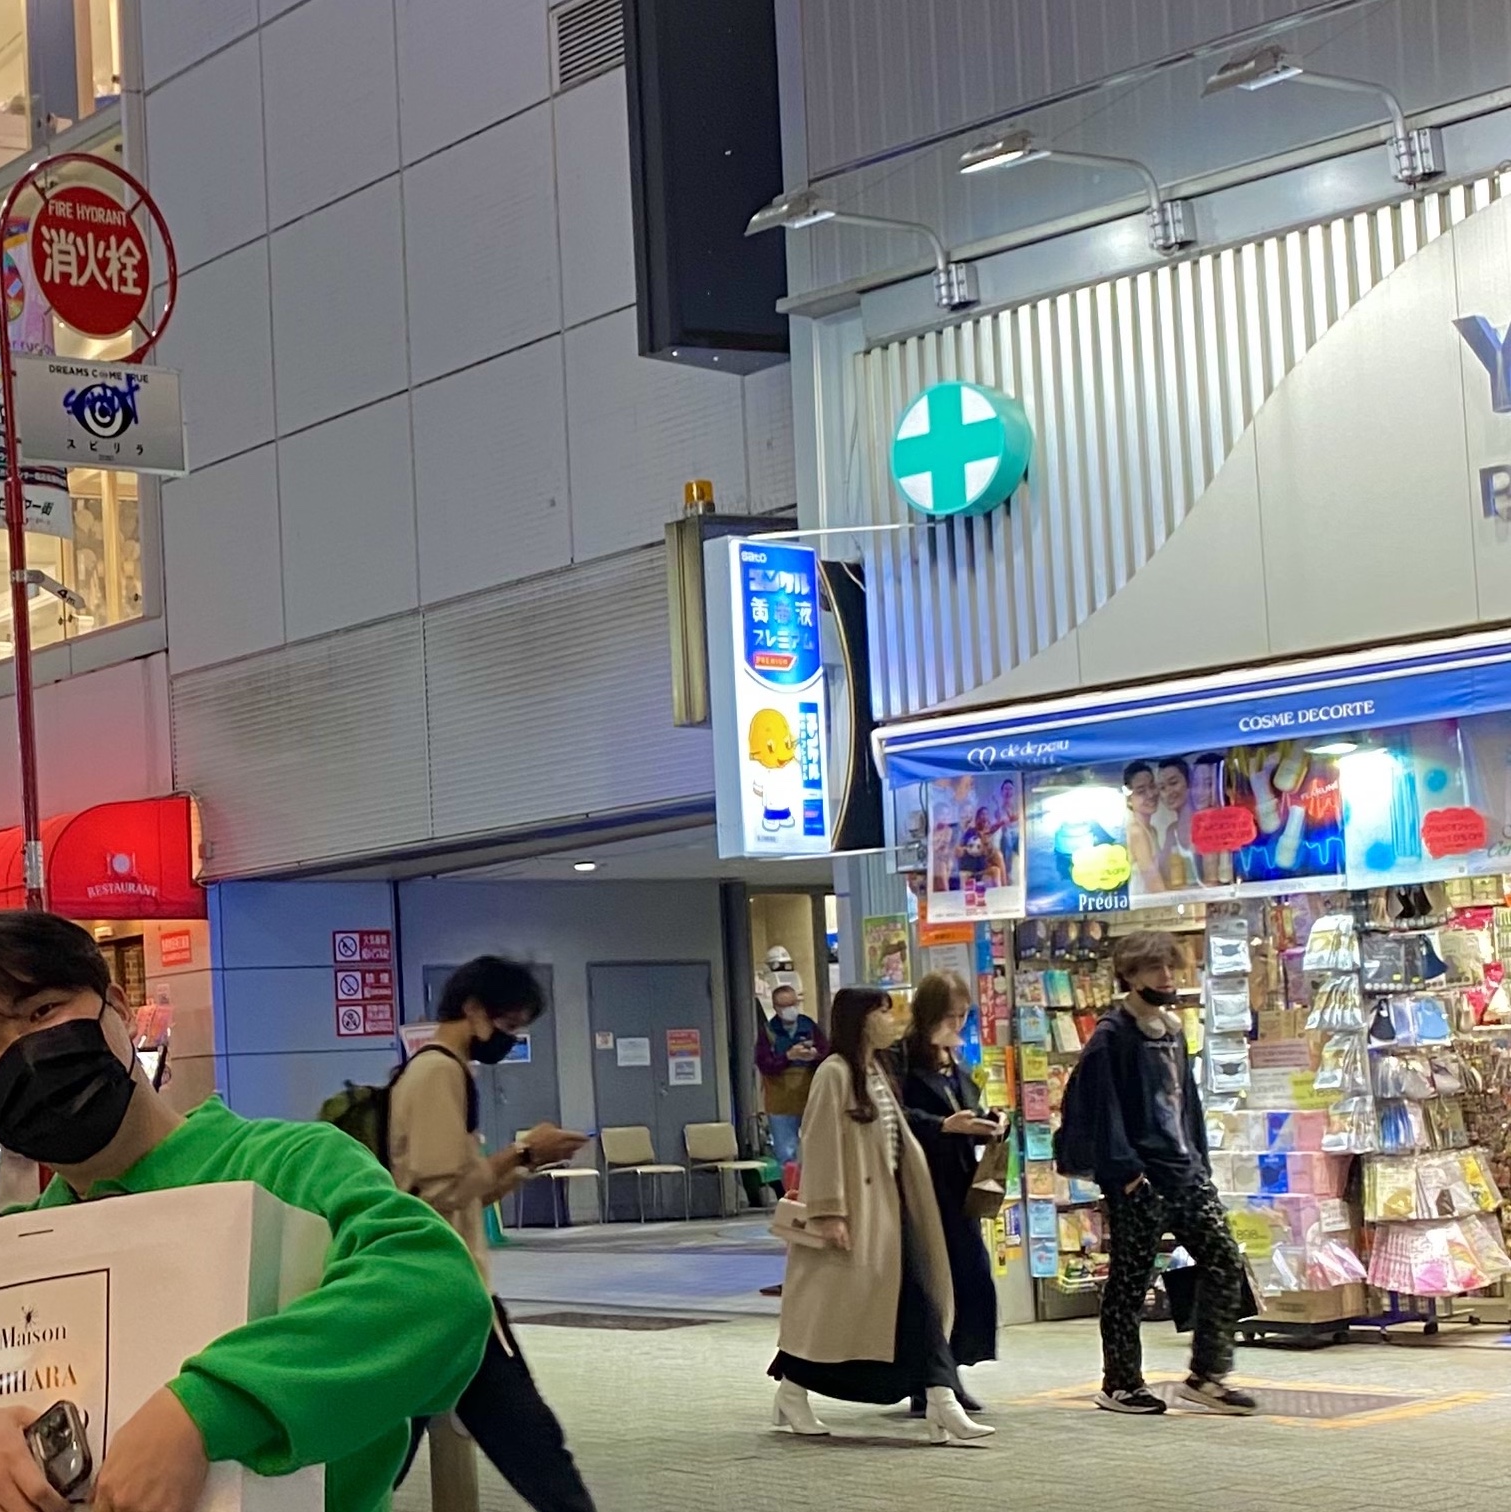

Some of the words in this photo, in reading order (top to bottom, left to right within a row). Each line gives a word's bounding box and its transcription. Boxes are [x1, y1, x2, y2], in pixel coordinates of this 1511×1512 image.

[48, 200, 74, 219] FIRE
[76, 203, 127, 227] HYDRANT
[41, 225, 142, 295] 消火栓
[48, 364, 89, 377] DREAMS
[125, 372, 149, 384] RUE
[1238, 711, 1295, 732] COSME
[87, 882, 159, 899] RESTAURANT
[0, 1324, 67, 1350] Maison
